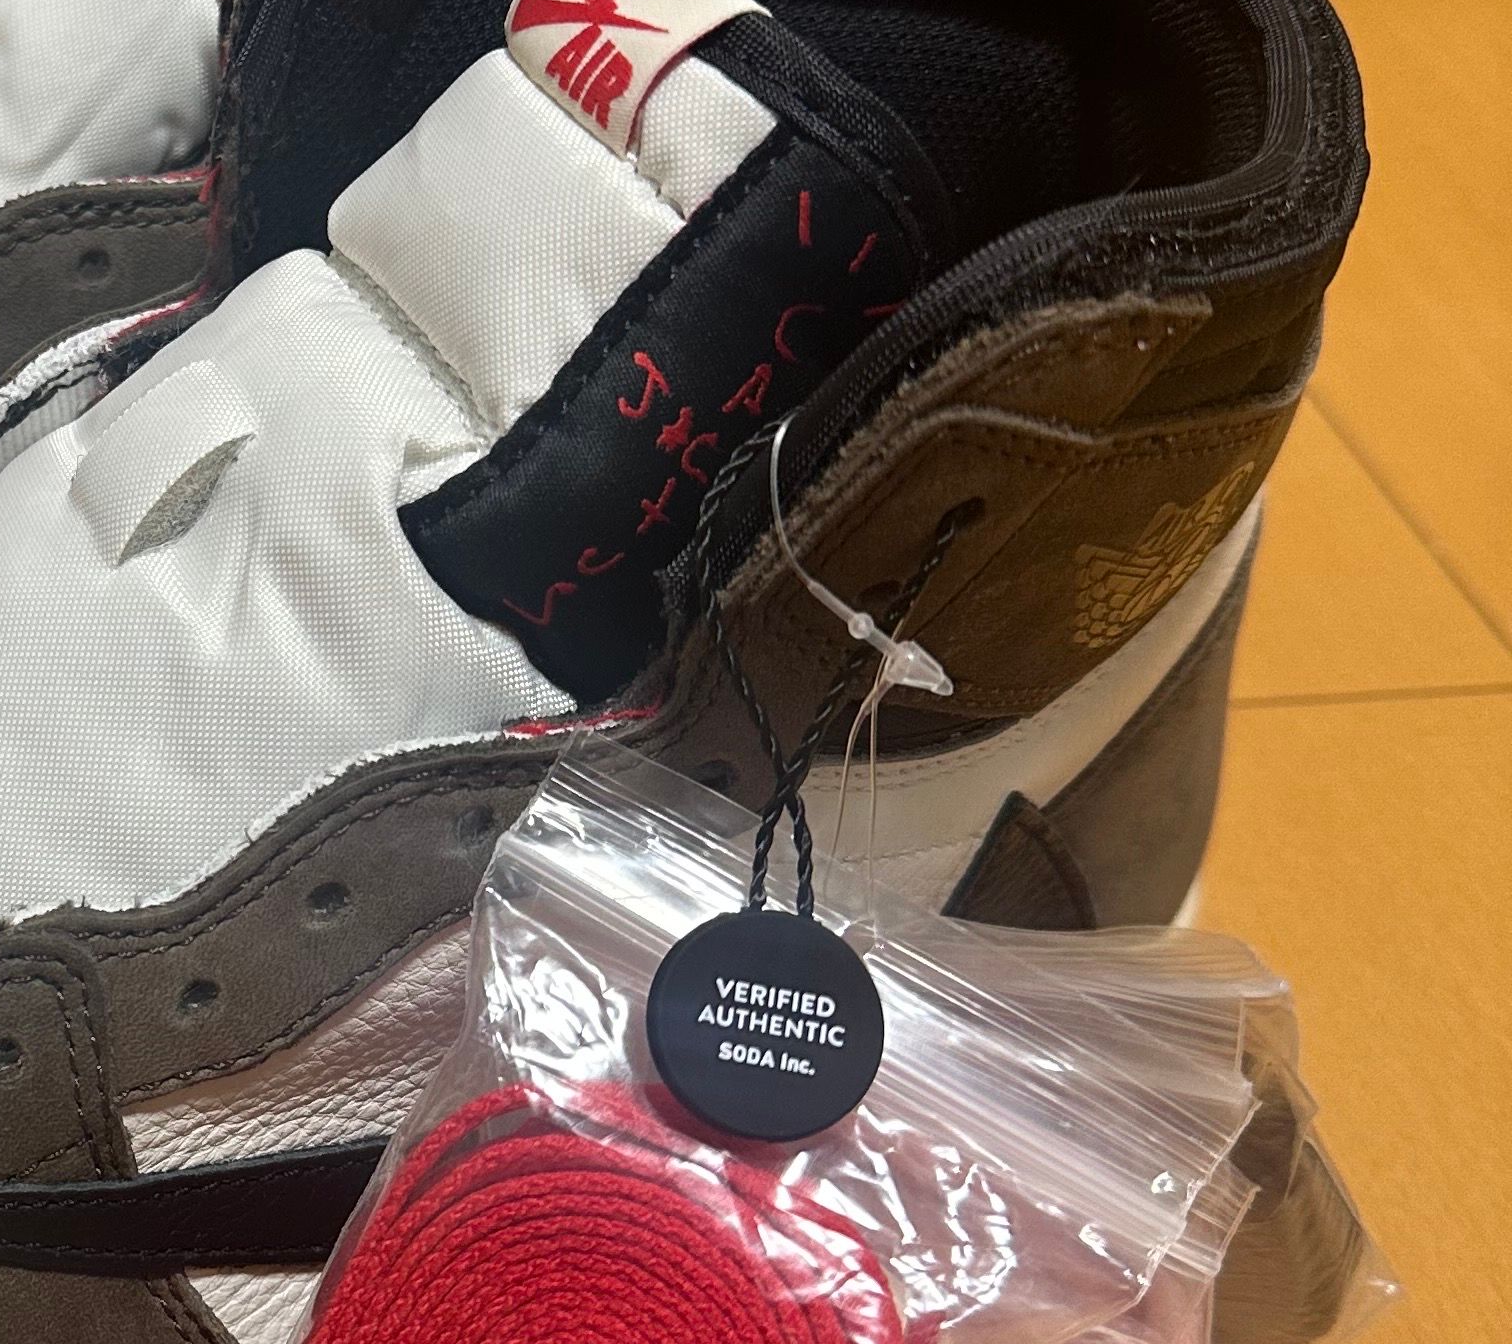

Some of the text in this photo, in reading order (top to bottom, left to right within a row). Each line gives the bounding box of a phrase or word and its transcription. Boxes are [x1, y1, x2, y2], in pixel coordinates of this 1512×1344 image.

[545, 25, 634, 130] AIR
[716, 977, 836, 1018] VERIFIED
[697, 1003, 847, 1048] AUTHENTIC
[718, 1041, 816, 1076] SODA Inc.
